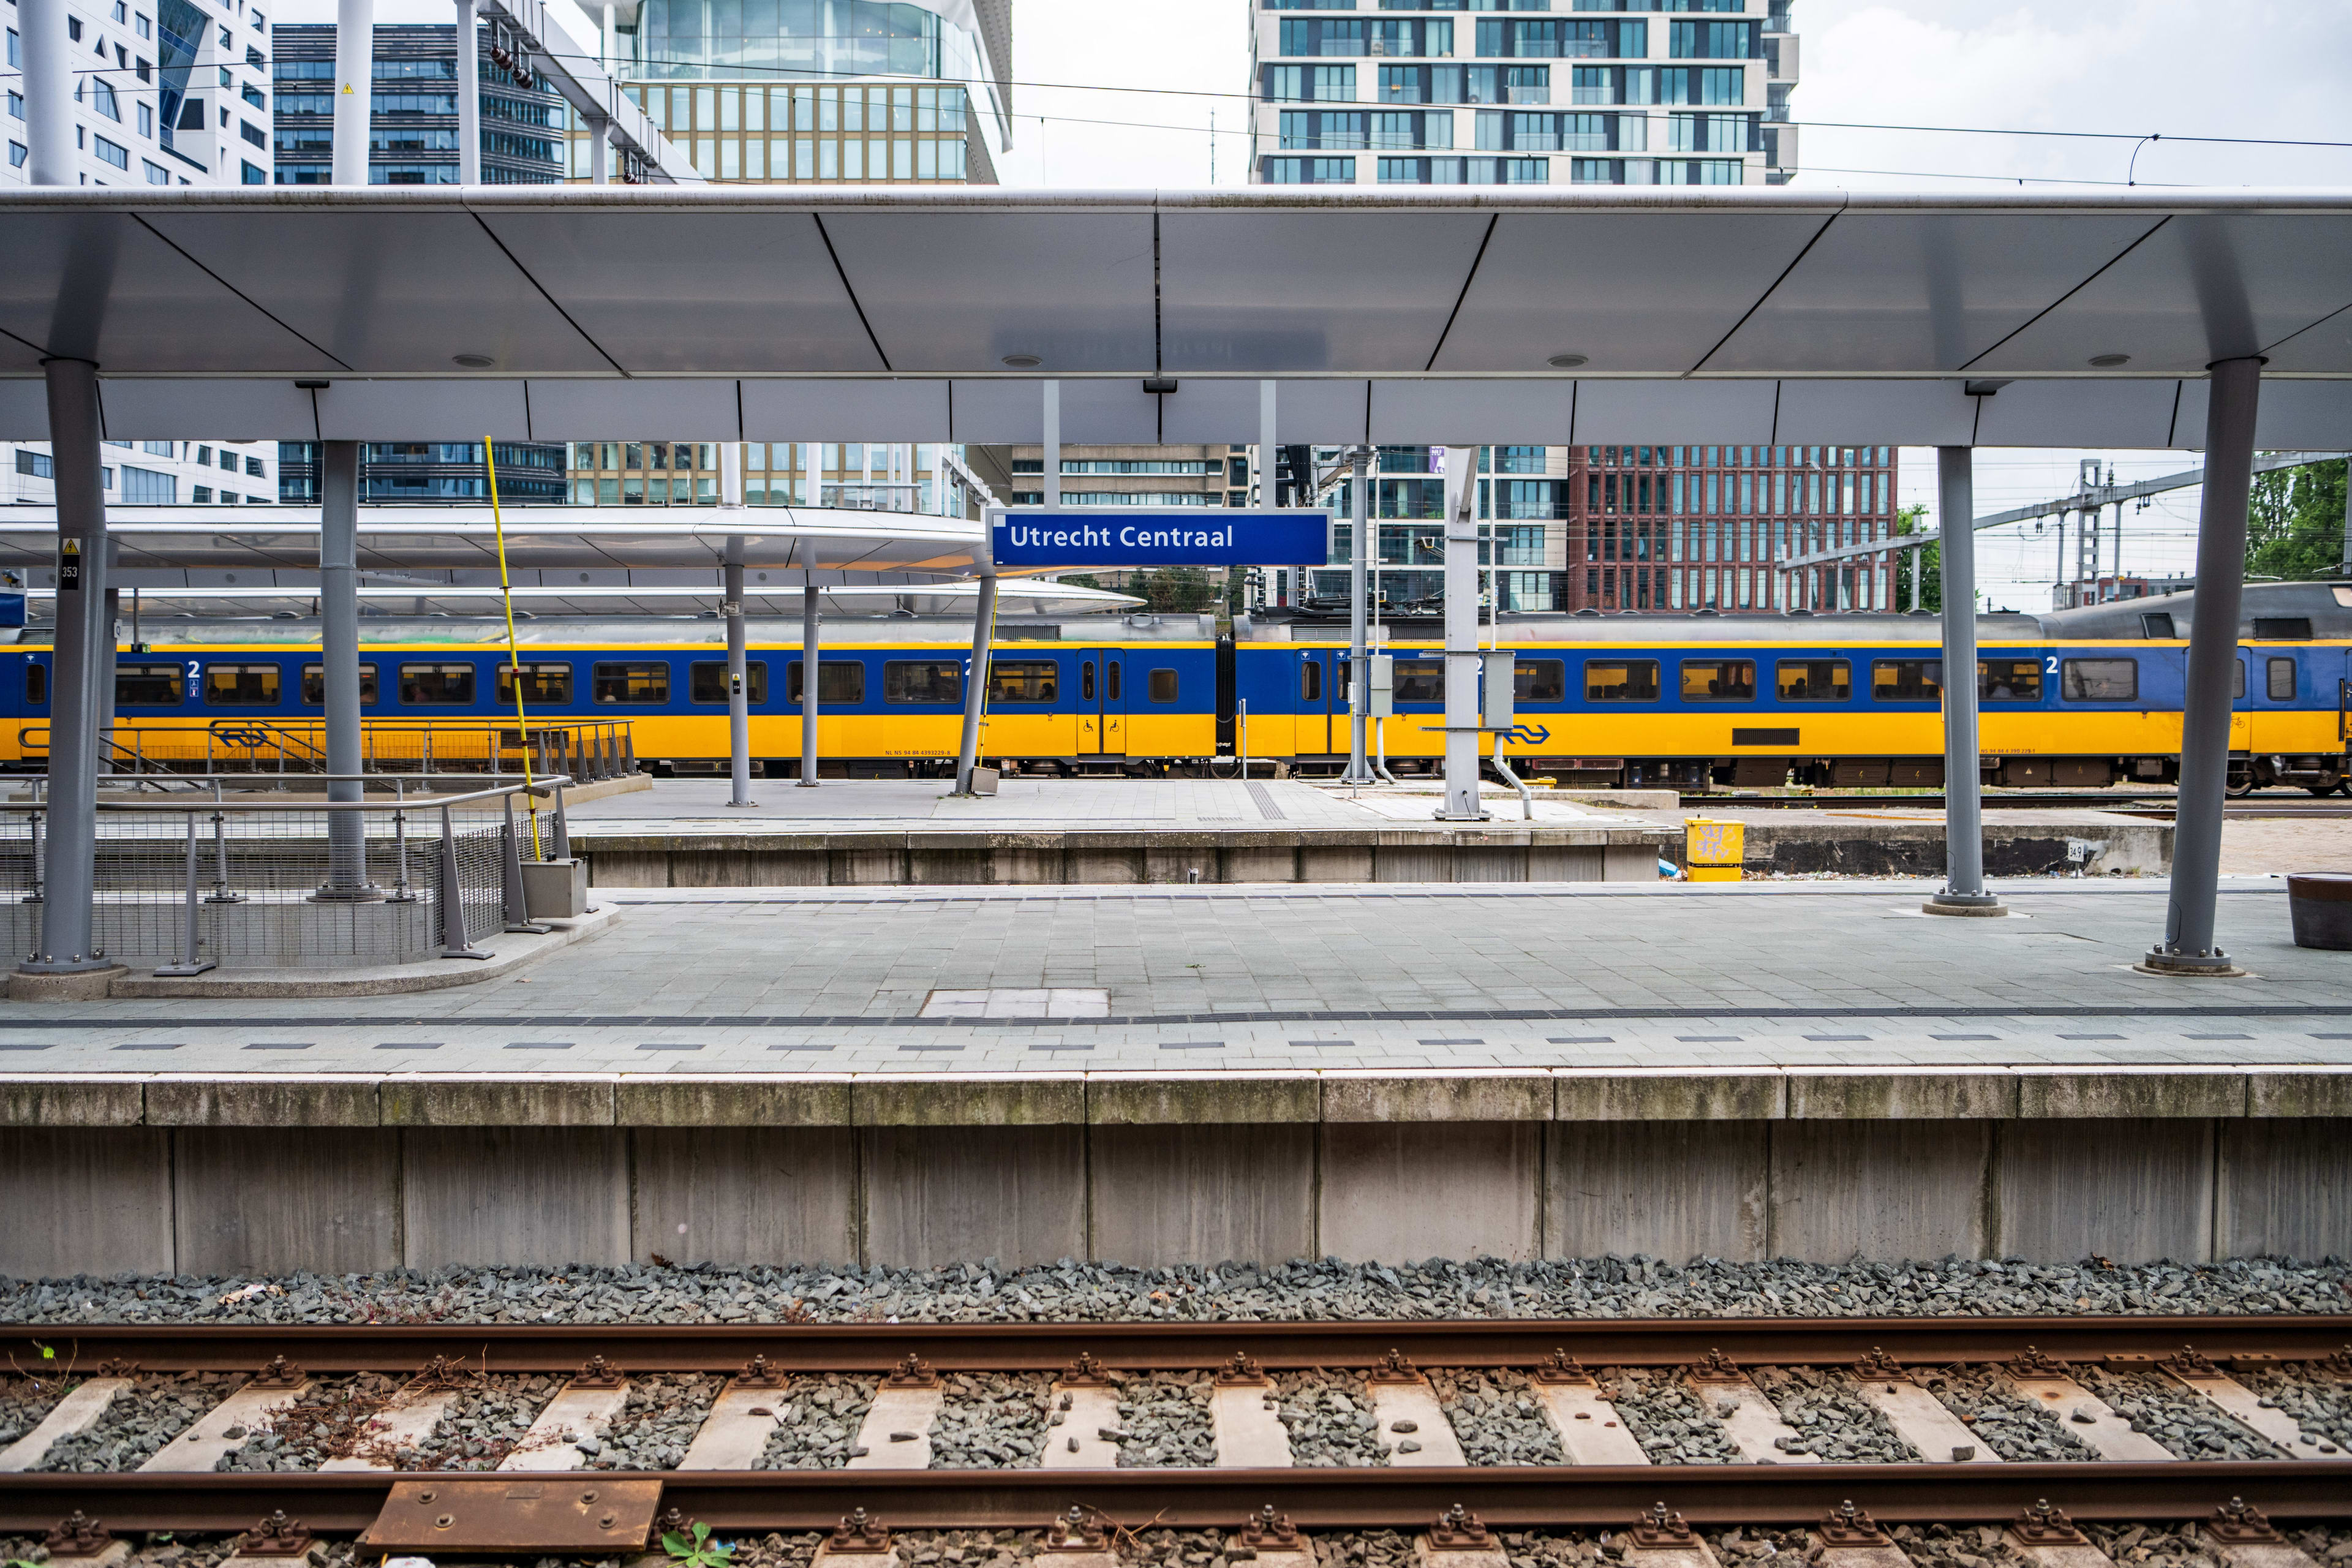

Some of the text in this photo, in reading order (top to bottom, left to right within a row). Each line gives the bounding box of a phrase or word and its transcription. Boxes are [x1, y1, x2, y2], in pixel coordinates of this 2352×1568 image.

[1011, 525, 1232, 547] Utrecht Centraal
[62, 567, 78, 577] 353
[116, 626, 121, 636] Q
[188, 660, 200, 678] 2
[2046, 656, 2058, 674] 2
